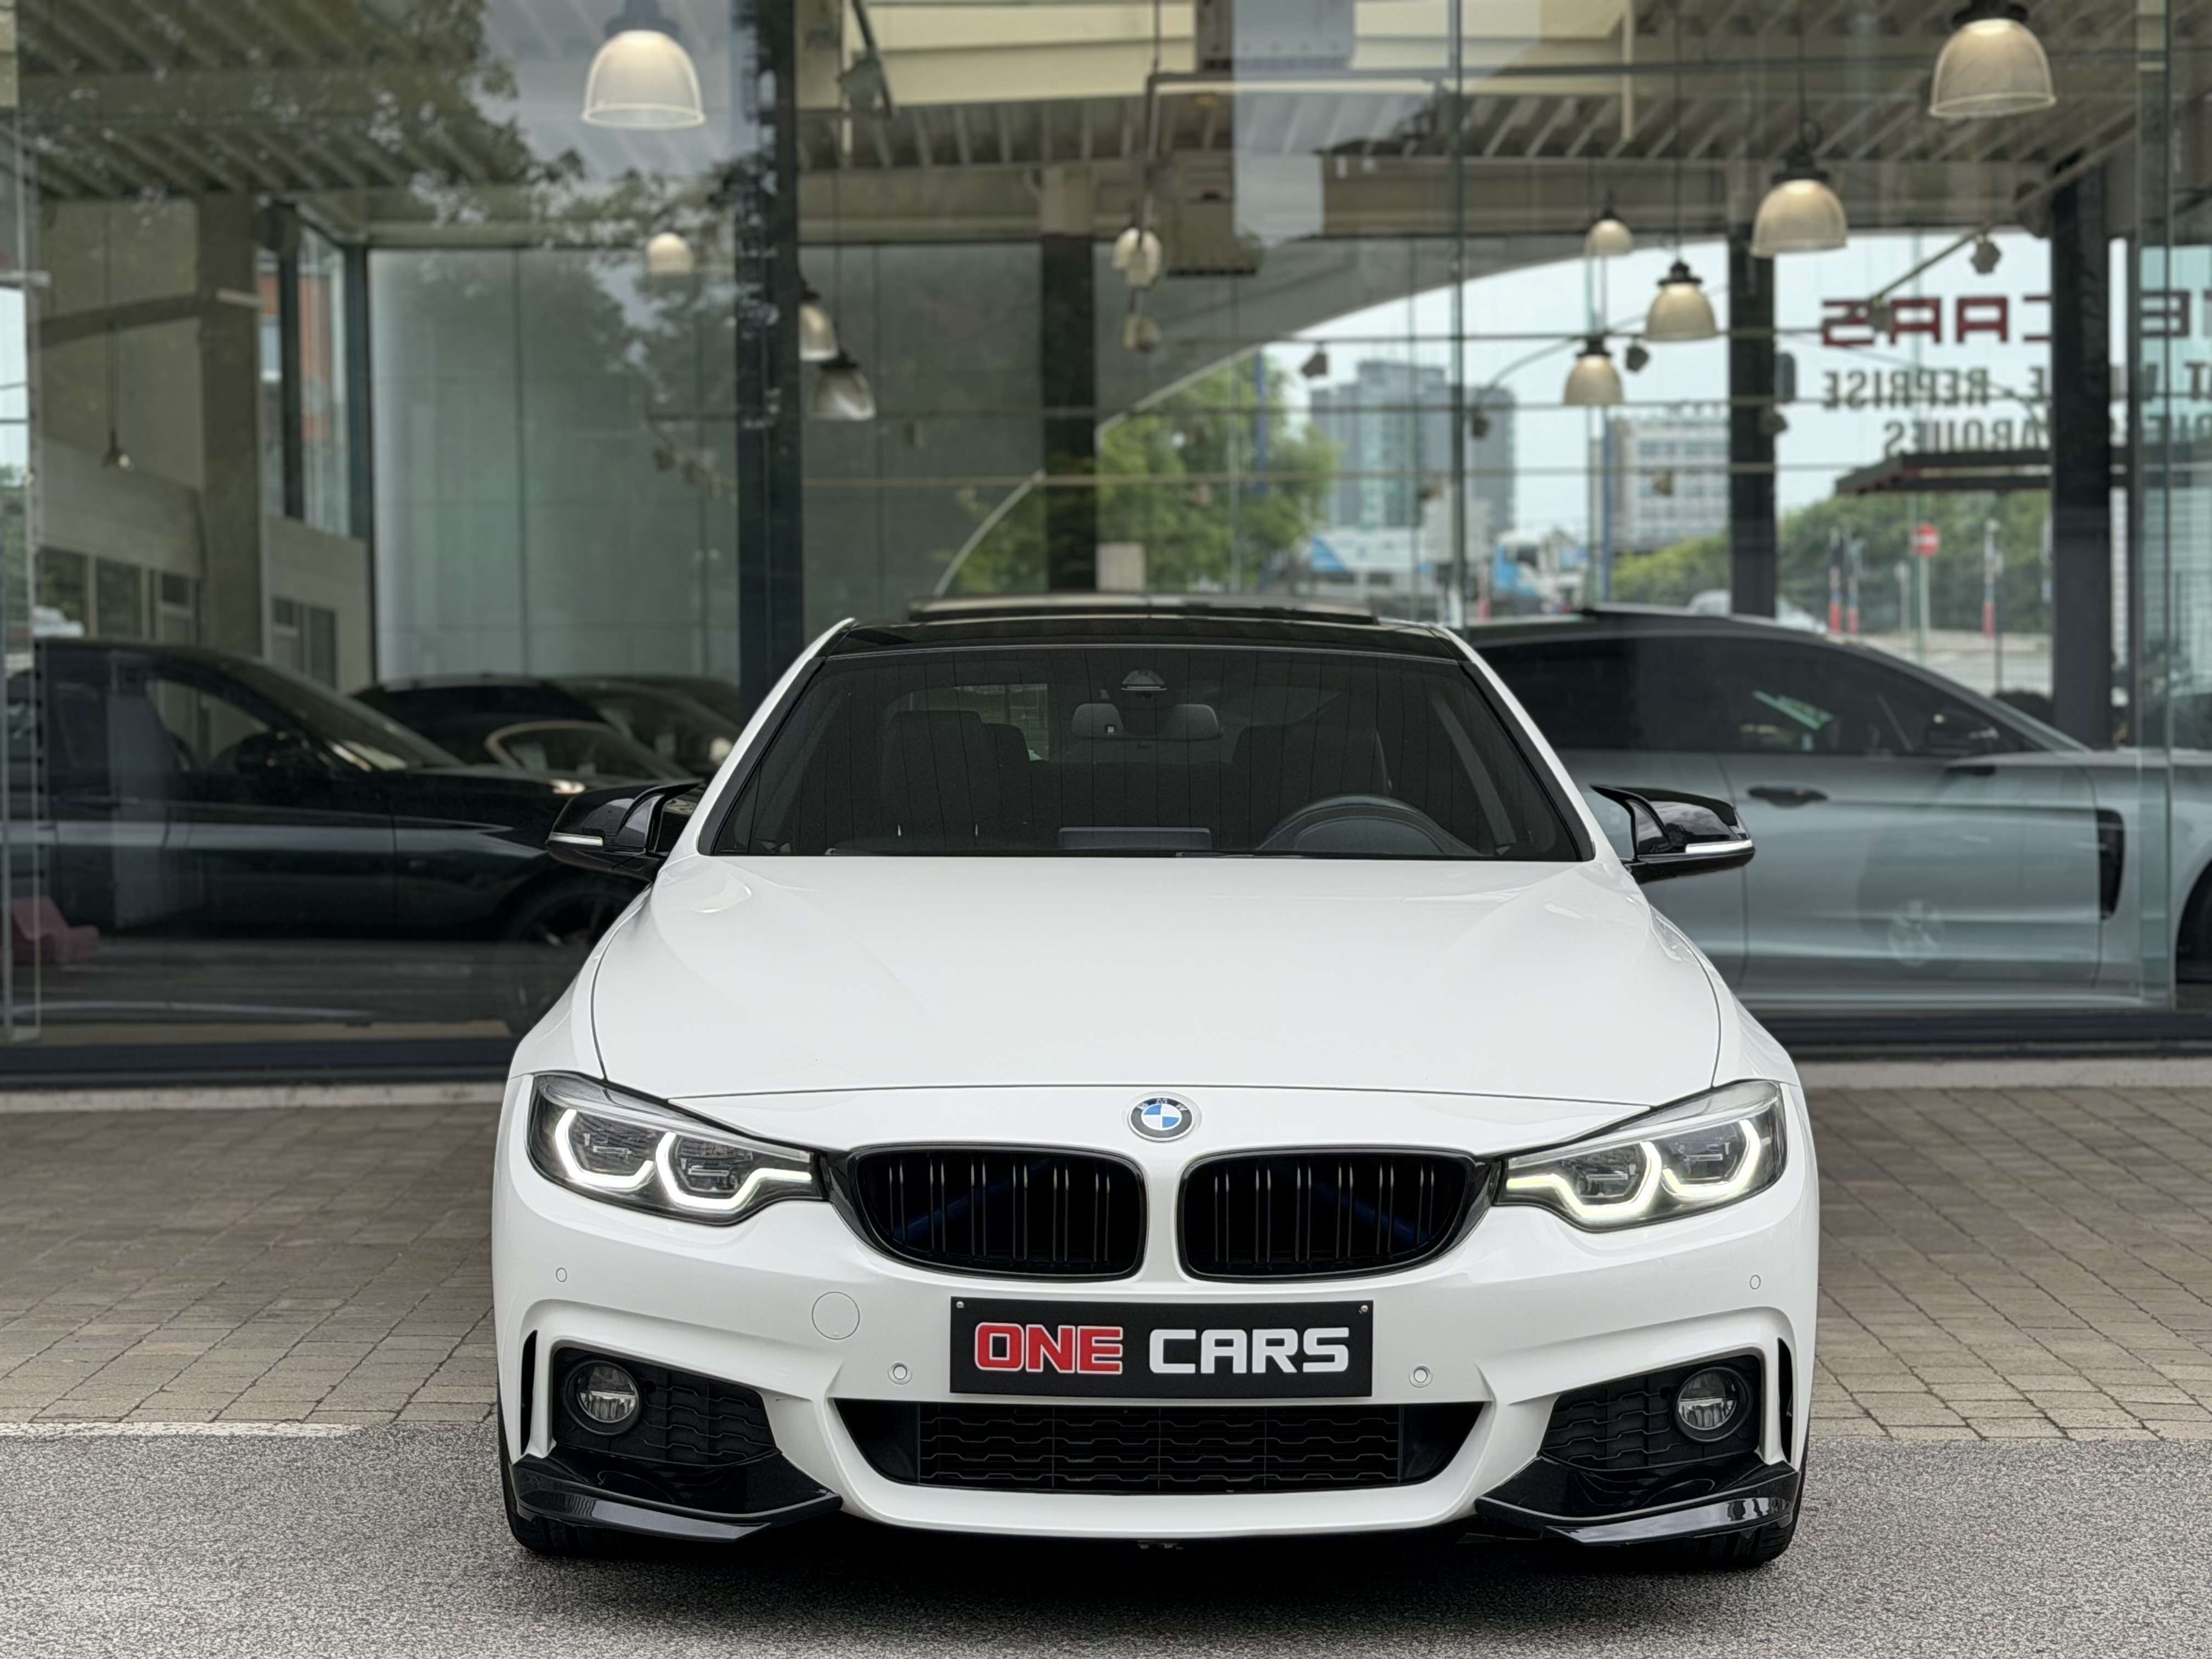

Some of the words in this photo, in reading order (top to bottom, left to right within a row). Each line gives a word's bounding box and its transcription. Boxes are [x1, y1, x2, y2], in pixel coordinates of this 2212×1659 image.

[1137, 1098, 1188, 1110] BMW
[974, 1322, 1122, 1374] ONE
[1149, 1327, 1349, 1373] CARS
